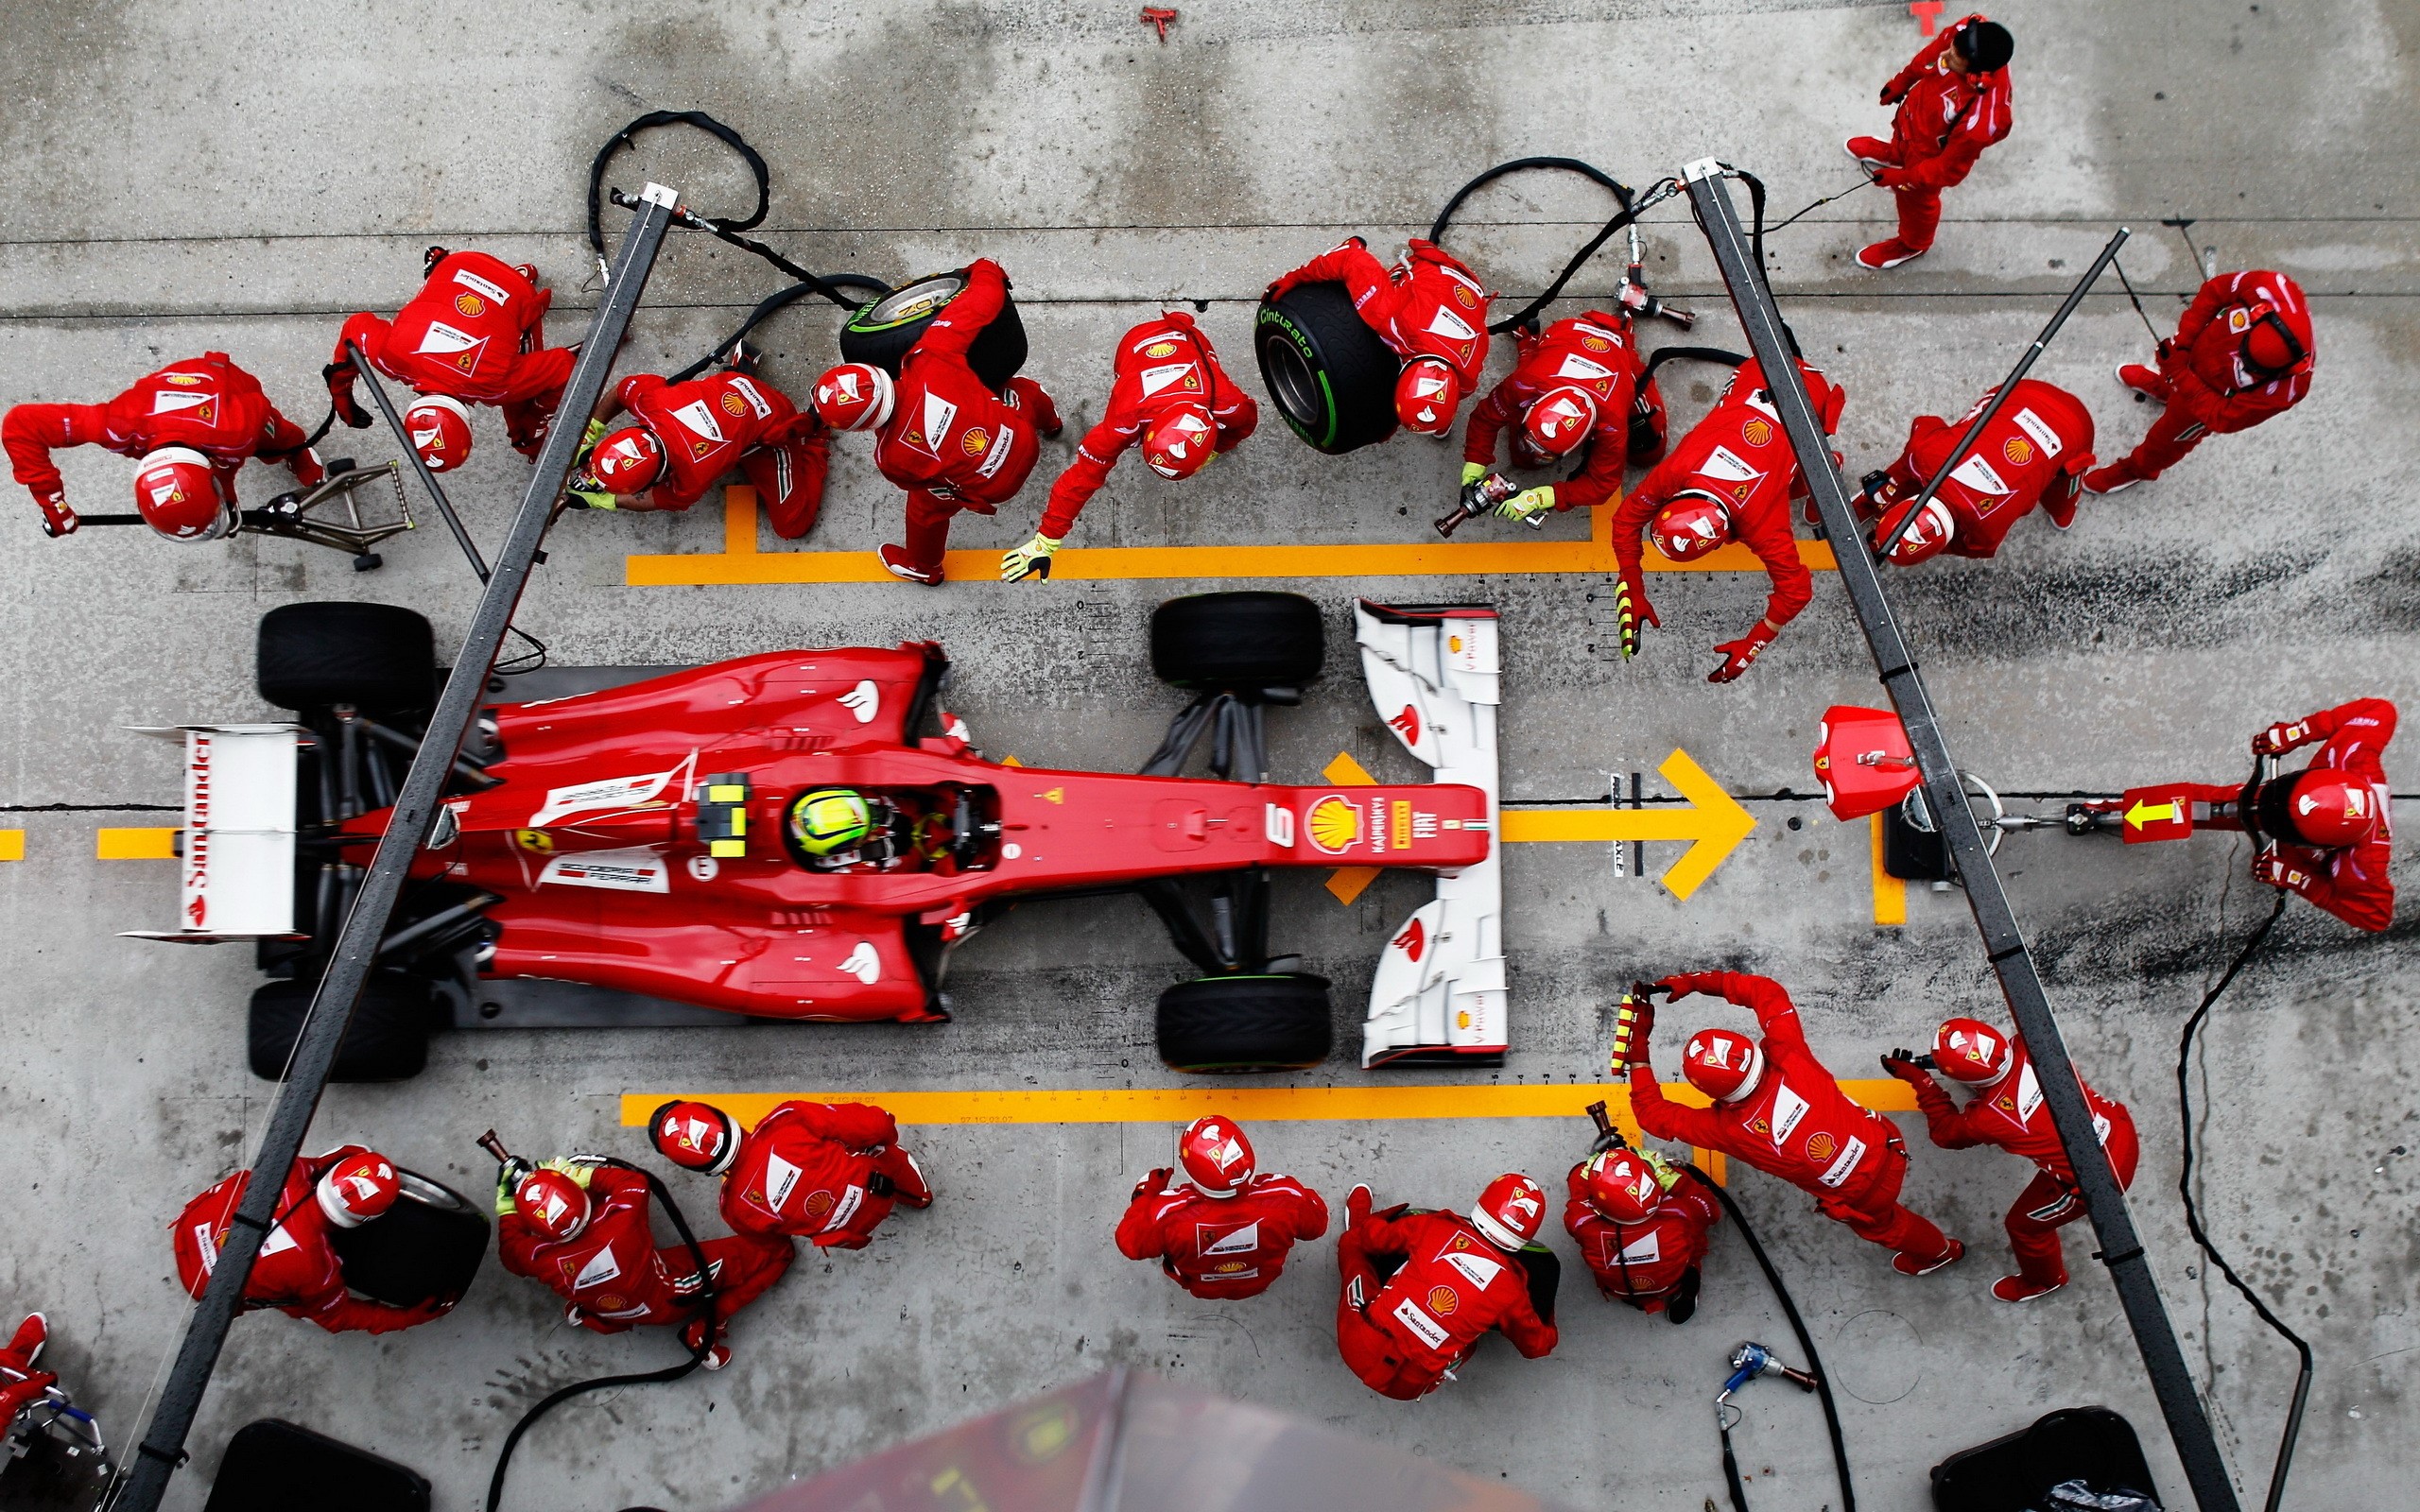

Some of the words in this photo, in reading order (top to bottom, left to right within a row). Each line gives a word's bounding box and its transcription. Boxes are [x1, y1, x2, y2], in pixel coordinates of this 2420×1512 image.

[458, 271, 496, 295] Santander
[1259, 309, 1312, 358] Cinturato
[735, 375, 763, 408] Santander
[2020, 412, 2053, 445] Santander
[988, 430, 1012, 468] Santander
[1077, 600, 1084, 610] 0
[1586, 593, 1595, 603] 0
[1077, 650, 1084, 660] 2
[1587, 643, 1595, 653] 2
[187, 736, 210, 888] Santander
[1265, 802, 1294, 847] 6
[1412, 811, 1437, 837] FIAT
[559, 862, 636, 875] SCUDERIA
[1121, 1058, 1129, 1068] 0
[1833, 1142, 1861, 1179] Santander
[835, 1189, 858, 1226] Santander
[1406, 1312, 1442, 1344] Santander
